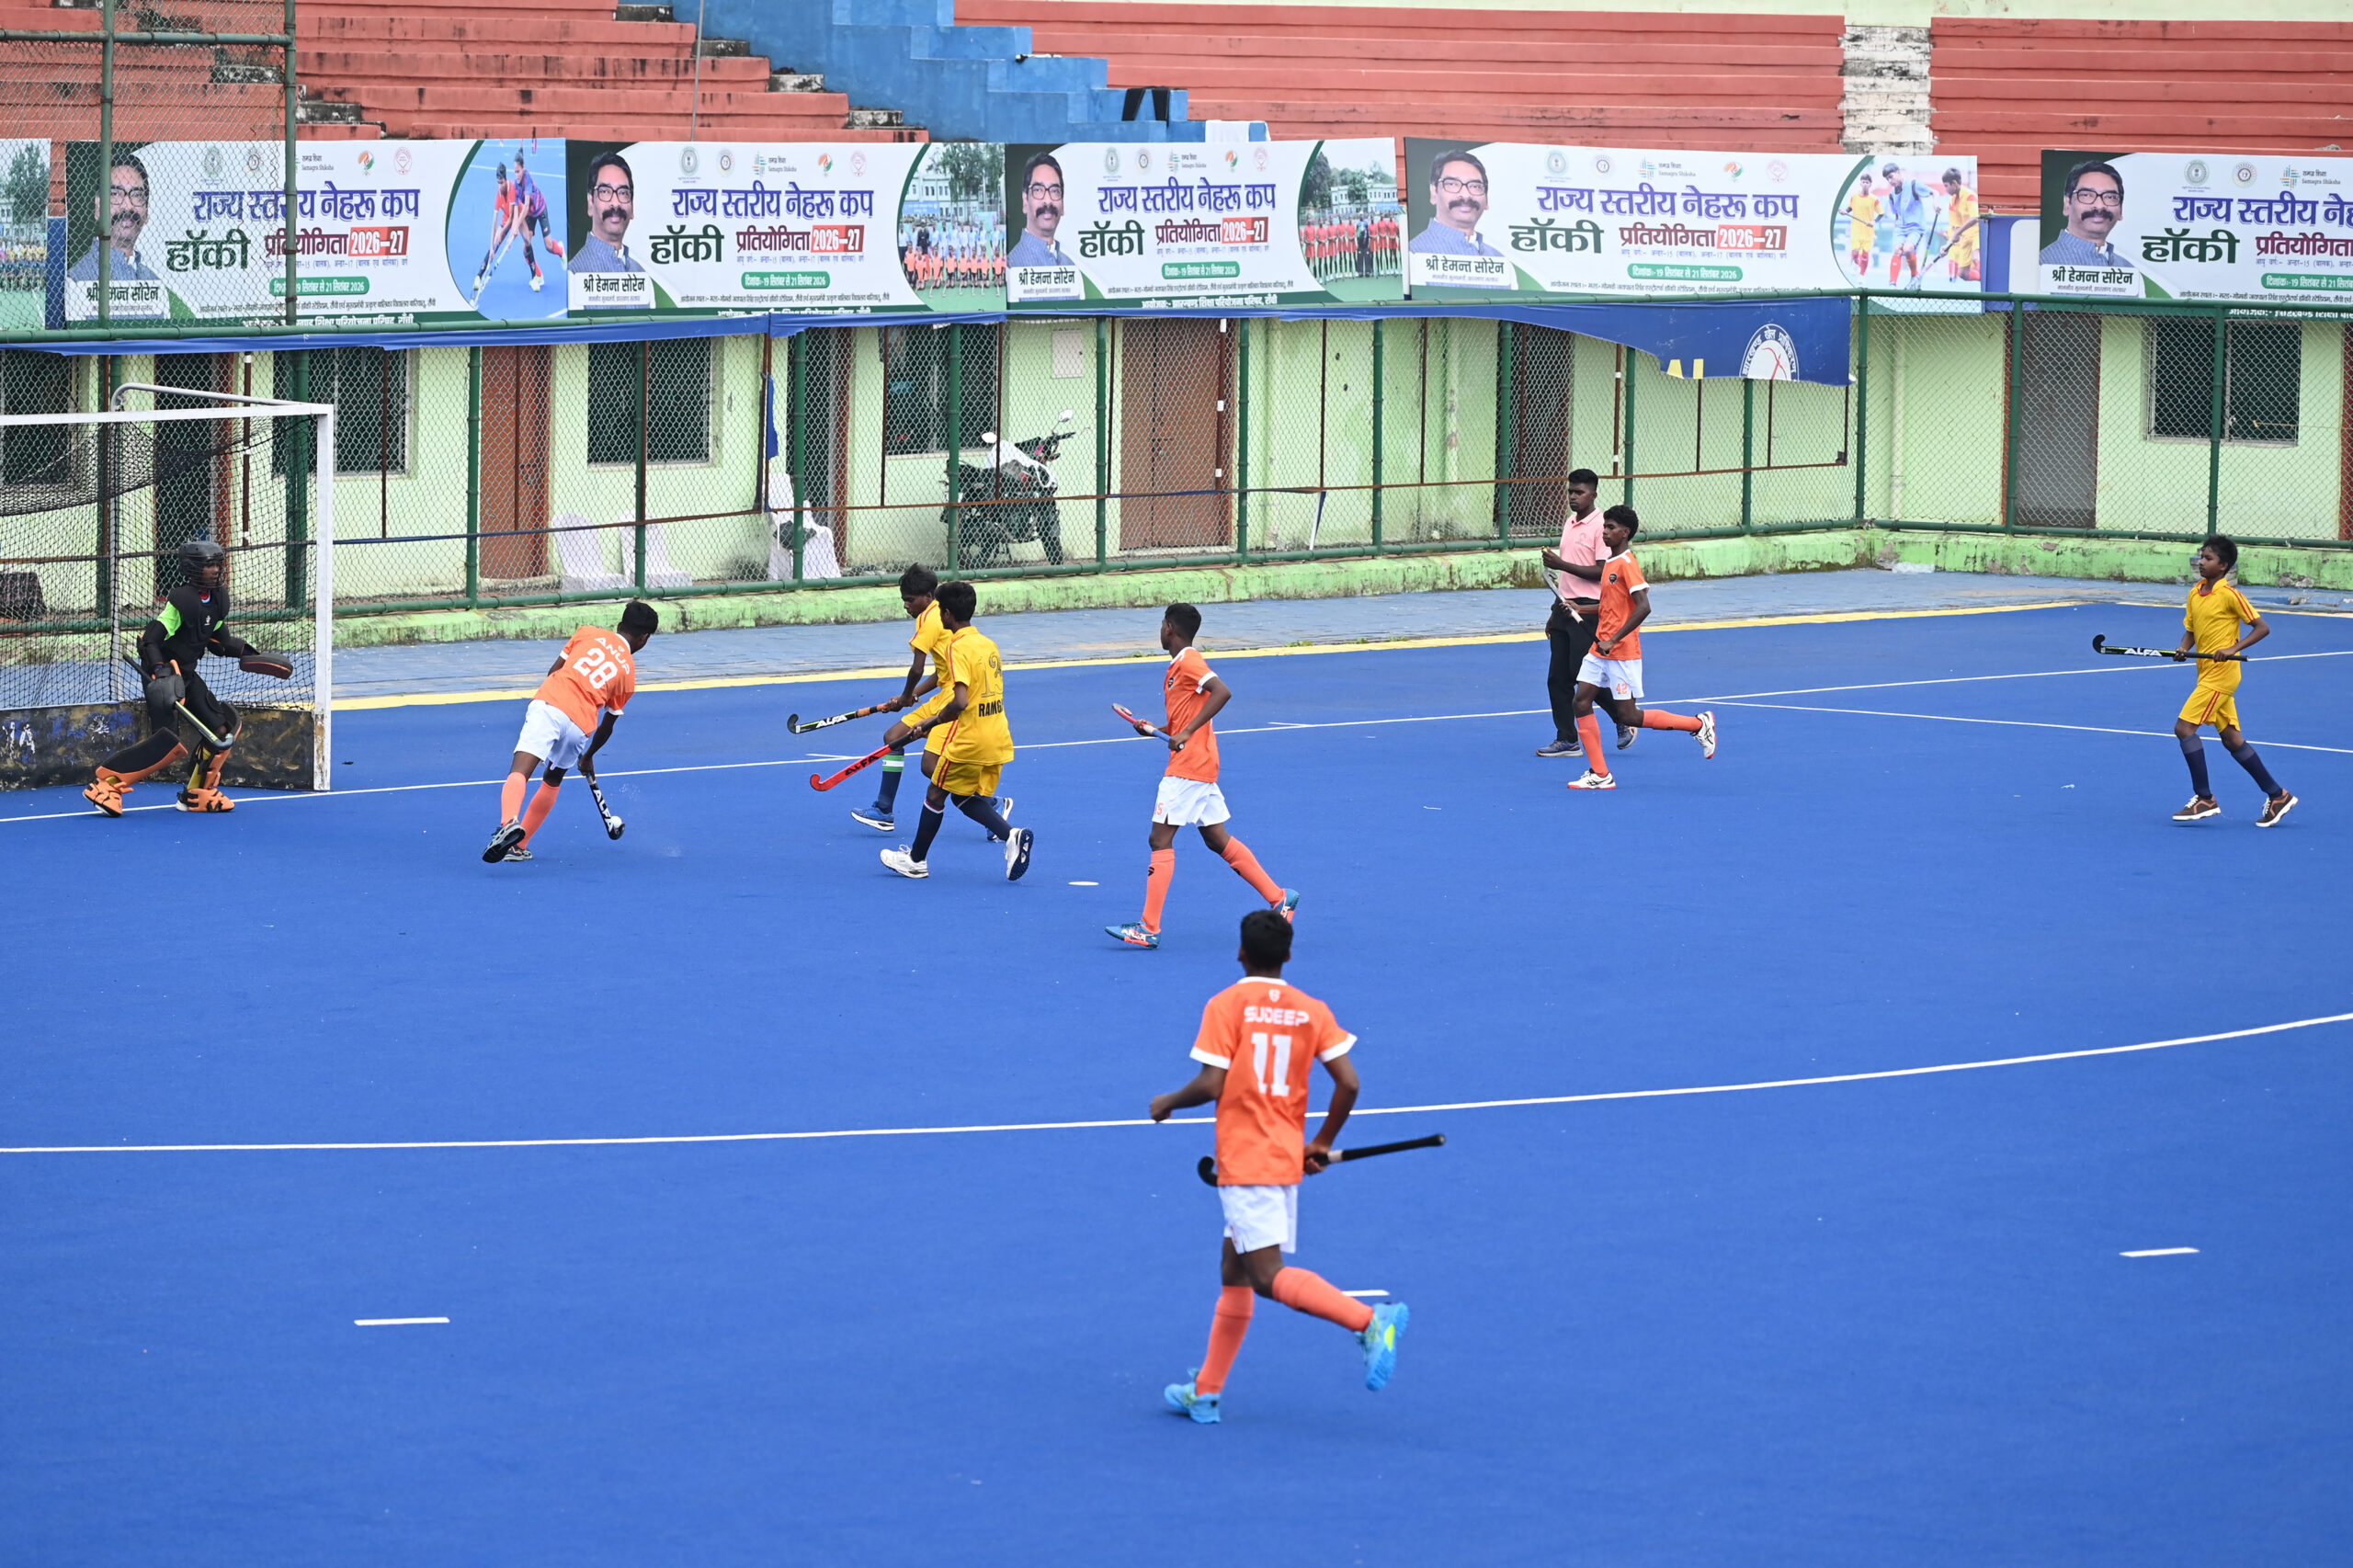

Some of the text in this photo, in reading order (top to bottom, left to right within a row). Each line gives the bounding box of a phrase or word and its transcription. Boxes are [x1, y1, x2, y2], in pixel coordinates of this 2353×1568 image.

[193, 190, 244, 222] राज्य
[320, 181, 377, 221] नेहरू
[381, 188, 421, 219] कप
[672, 179, 874, 220] राज्य स्तरीय नेहरू कप
[1097, 176, 1276, 214] राज्य स्तरीय नेहरू कप
[1536, 182, 1799, 220] राज्य स्तरीय नेहरू कप
[2173, 196, 2234, 224] राज्य
[2238, 190, 2319, 226] स्तरीय
[165, 228, 251, 273] हॉकी
[350, 230, 404, 255] 2026-27
[649, 224, 724, 265] हॉकी
[735, 225, 811, 253] प्रतियोगिता
[813, 228, 860, 251] 2026-27
[1078, 220, 1145, 258] हॉकी
[1155, 218, 1222, 245] प्रतियोगिता
[1508, 217, 1604, 254] हॉकी
[1619, 222, 1716, 248] प्रतियोगिता
[1720, 228, 1781, 249] 2026-27
[2141, 228, 2240, 264] हॉकी
[1018, 267, 1075, 286] श्री हेमन्त सोरेन
[1426, 255, 1505, 275] श्री हेमन्त सोरेन
[1721, 270, 1737, 279] 2026
[2052, 266, 2133, 285] श्री हेमन्त सोरेन
[350, 282, 365, 291] 2026
[584, 274, 645, 293] श्री हेमन्त सोरेन
[2328, 279, 2336, 288] 21
[573, 648, 619, 689] 28
[595, 637, 631, 676] ANUP
[2124, 646, 2163, 657] ALFA
[1615, 683, 1628, 695] 42
[815, 713, 848, 729] ALFA
[978, 699, 1004, 718] RAMG
[845, 753, 880, 778] ALFA
[592, 789, 614, 833] ALFA
[1244, 1006, 1309, 1027] SUDEEP
[1251, 1031, 1292, 1096] 11
